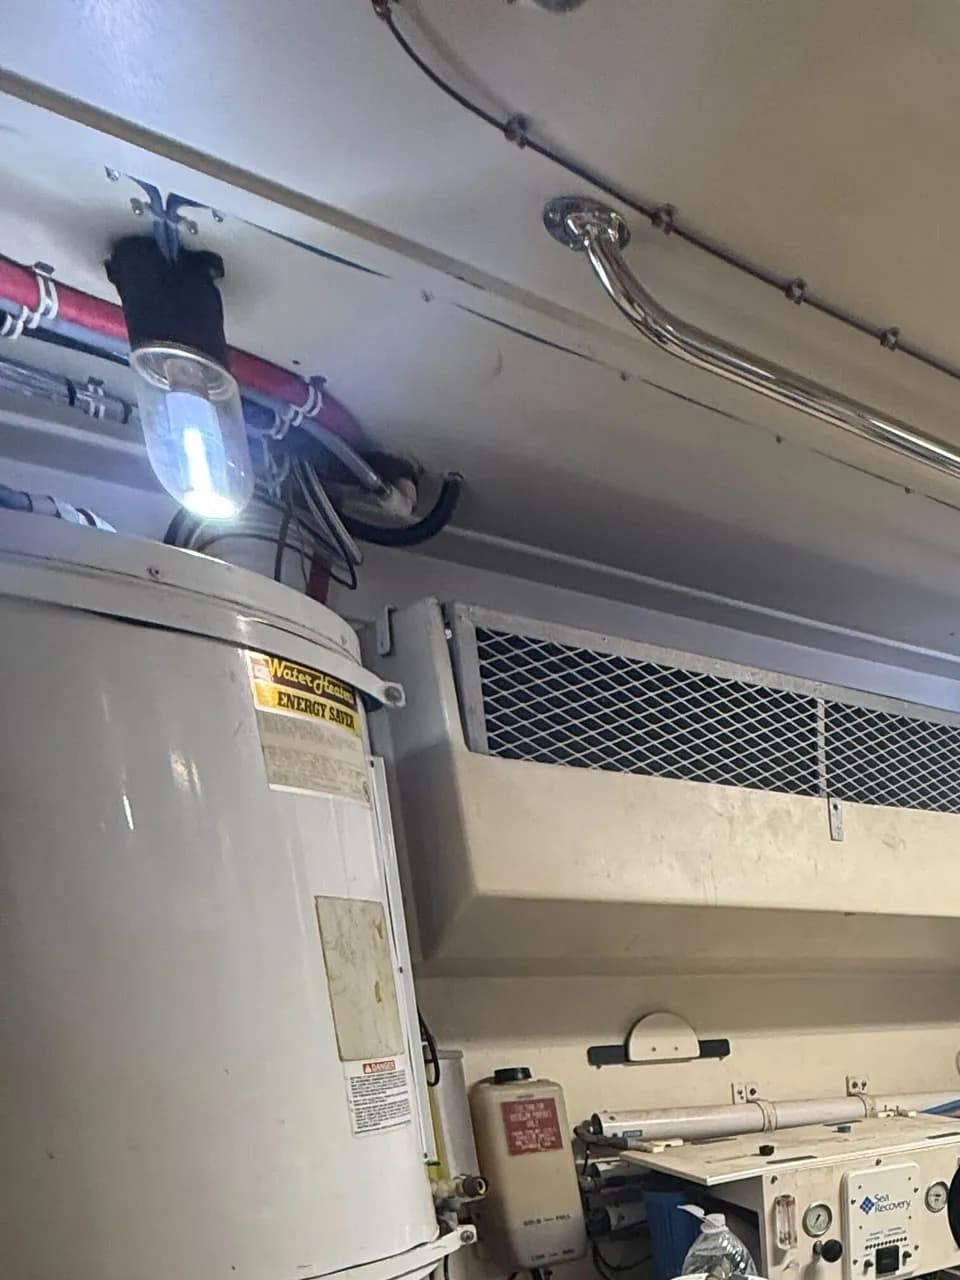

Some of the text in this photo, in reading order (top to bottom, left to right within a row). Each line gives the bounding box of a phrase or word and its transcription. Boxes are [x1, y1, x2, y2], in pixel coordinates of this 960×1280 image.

[269, 658, 314, 688] Water
[277, 690, 328, 720] ENERGY
[329, 708, 355, 730] SAVER
[874, 1193, 890, 1202] Sea
[874, 1200, 911, 1213] Recovery
